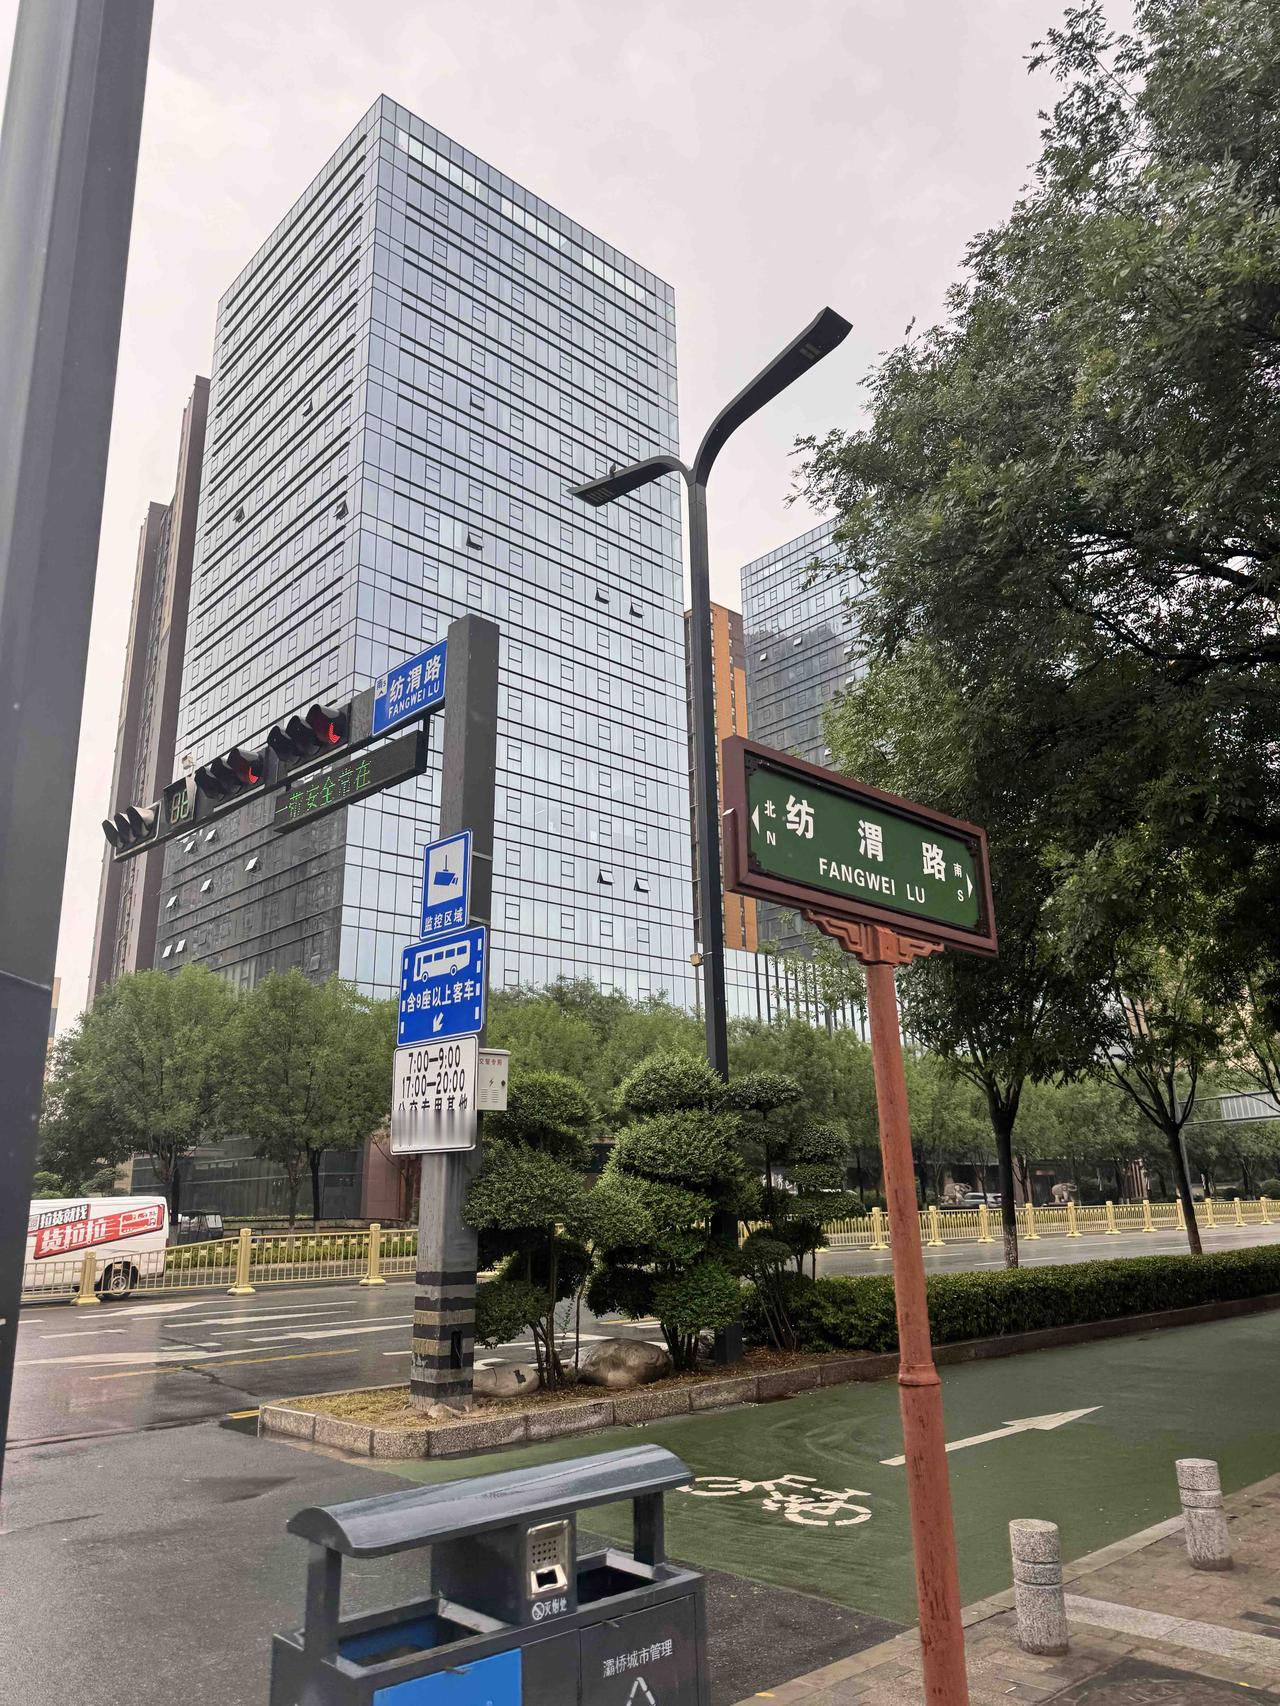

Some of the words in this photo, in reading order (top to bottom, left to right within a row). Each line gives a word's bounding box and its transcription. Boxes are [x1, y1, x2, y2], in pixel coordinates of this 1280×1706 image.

[389, 654, 442, 704] 纺渭路
[388, 688, 426, 719] FANGWEI
[427, 680, 441, 698] LU
[764, 799, 777, 819] 北
[766, 830, 776, 847] N
[785, 794, 947, 882] 纺渭路
[818, 857, 897, 897] FANGWEI
[906, 883, 926, 905] LU
[953, 862, 963, 878] 南
[957, 889, 965, 903] S
[424, 906, 464, 933] 监控区域
[407, 979, 475, 1012] 含9座以上客车
[40, 1205, 88, 1228] 拉货就找
[40, 1219, 107, 1253] 货拉拉
[544, 1597, 567, 1616] 灭烟处
[603, 1638, 673, 1679] 灞桥城市管理
